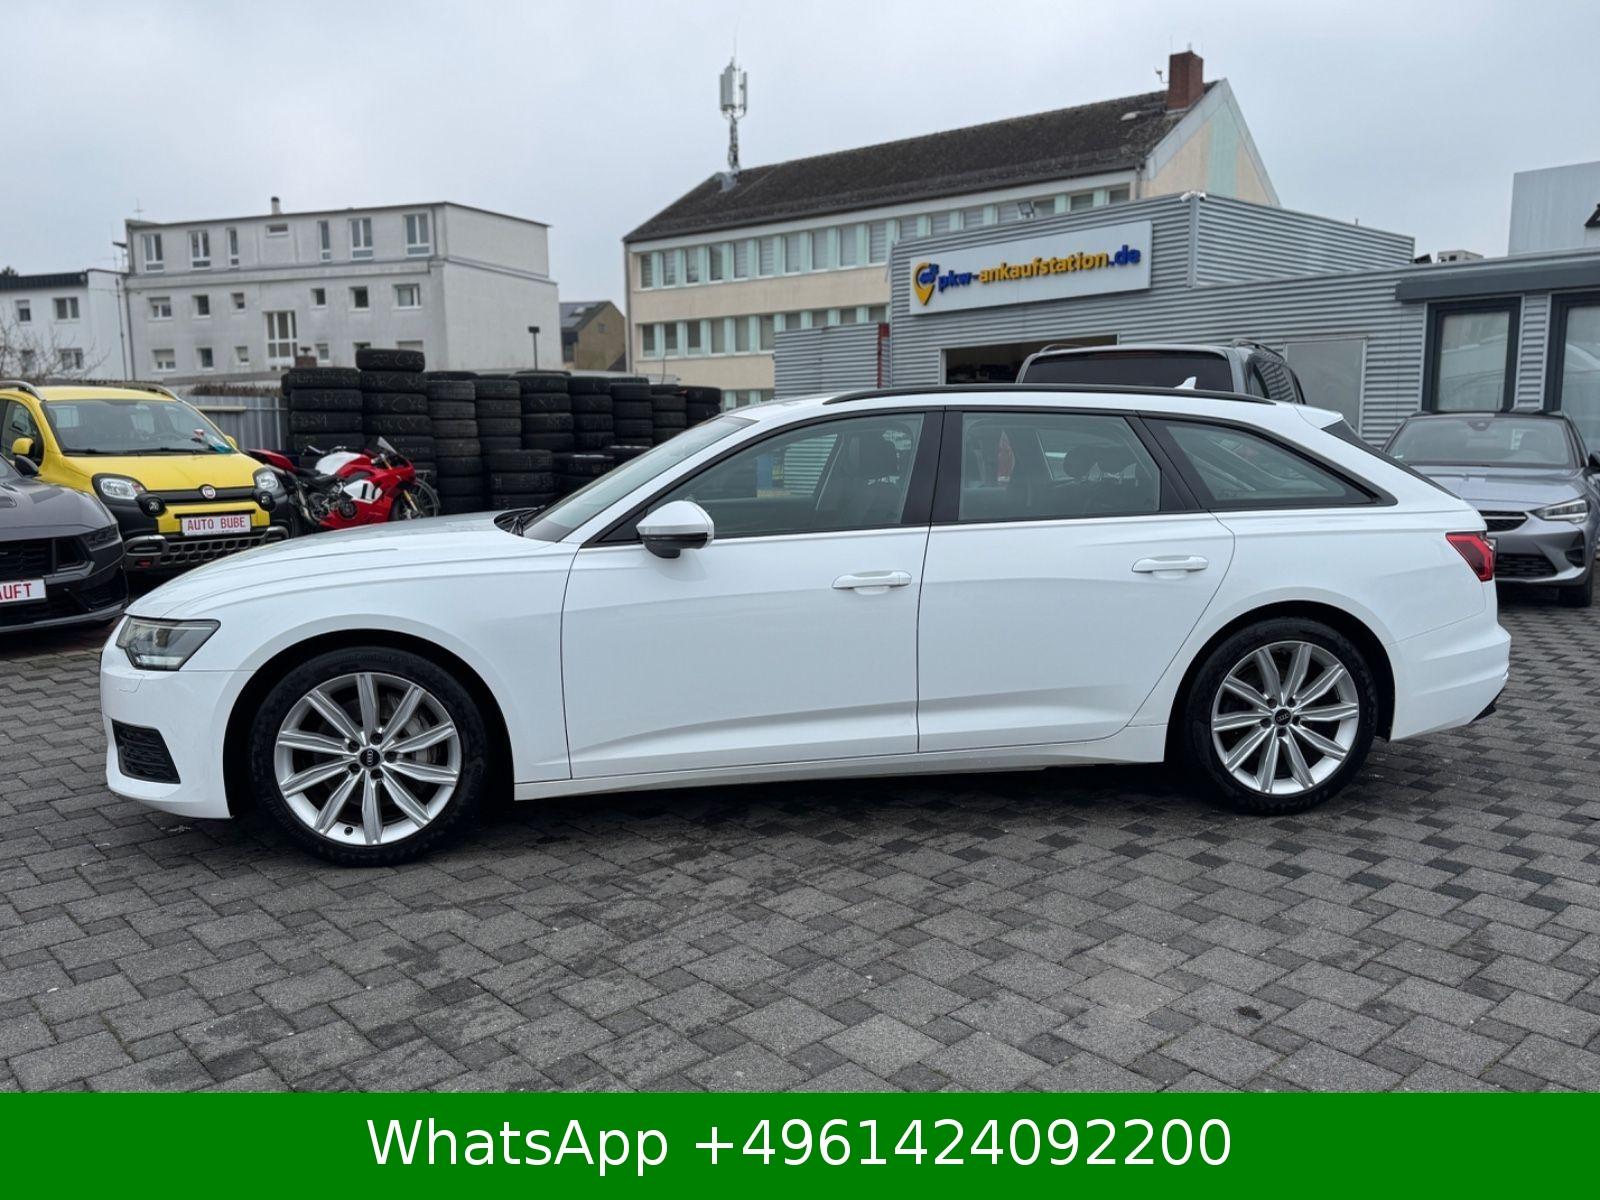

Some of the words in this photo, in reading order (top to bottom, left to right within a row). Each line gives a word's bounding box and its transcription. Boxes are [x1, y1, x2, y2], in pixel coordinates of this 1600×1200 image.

[938, 244, 1141, 292] pkw-ankaufstation.de
[188, 518, 215, 531] AUTO
[220, 516, 246, 529] BUBE
